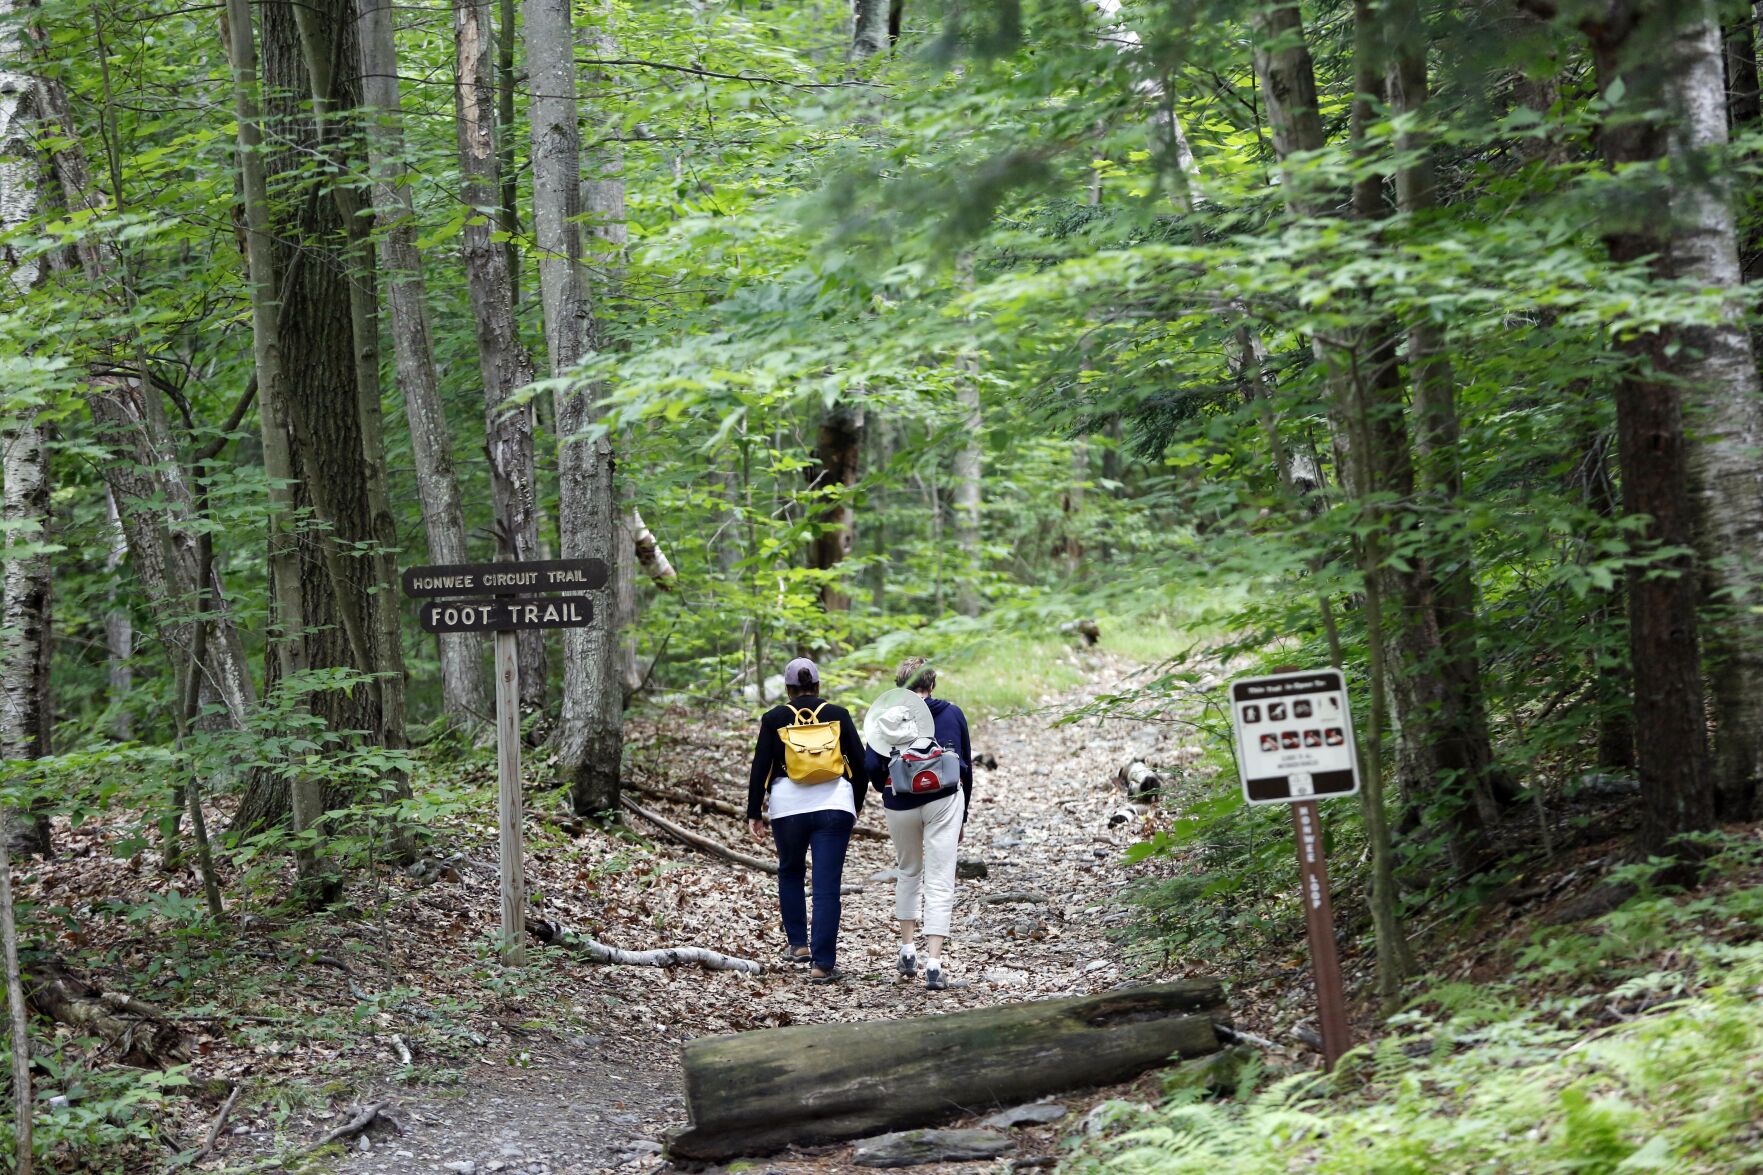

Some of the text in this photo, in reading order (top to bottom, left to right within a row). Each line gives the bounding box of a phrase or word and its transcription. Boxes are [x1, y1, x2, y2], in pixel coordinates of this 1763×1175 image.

[413, 569, 587, 590] HONWEE CIRCUIT TRAIL
[431, 602, 582, 626] FOOT TRAIL
[1309, 874, 1322, 909] LOOP
